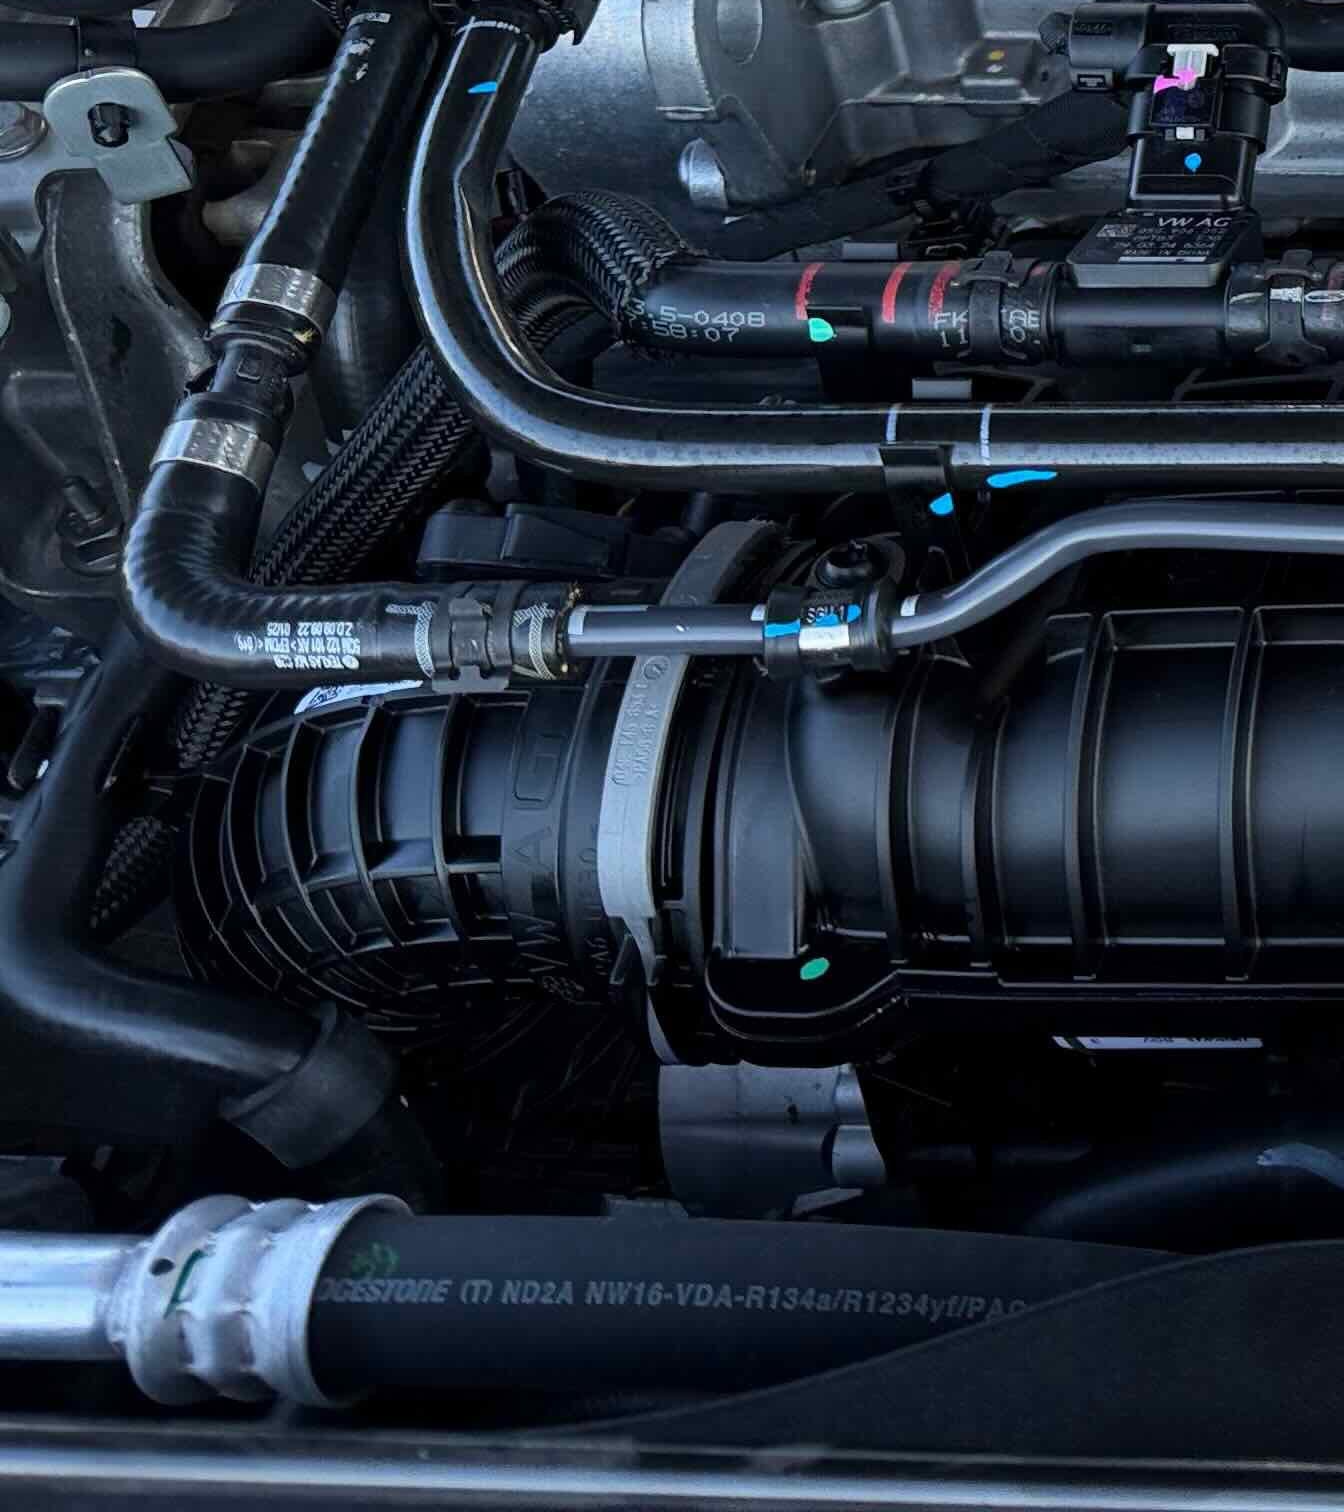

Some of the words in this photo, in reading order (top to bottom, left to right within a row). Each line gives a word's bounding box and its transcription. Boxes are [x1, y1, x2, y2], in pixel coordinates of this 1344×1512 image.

[1158, 217, 1193, 227] VW
[1196, 217, 1232, 227] AG
[501, 1278, 576, 1305] ND2A
